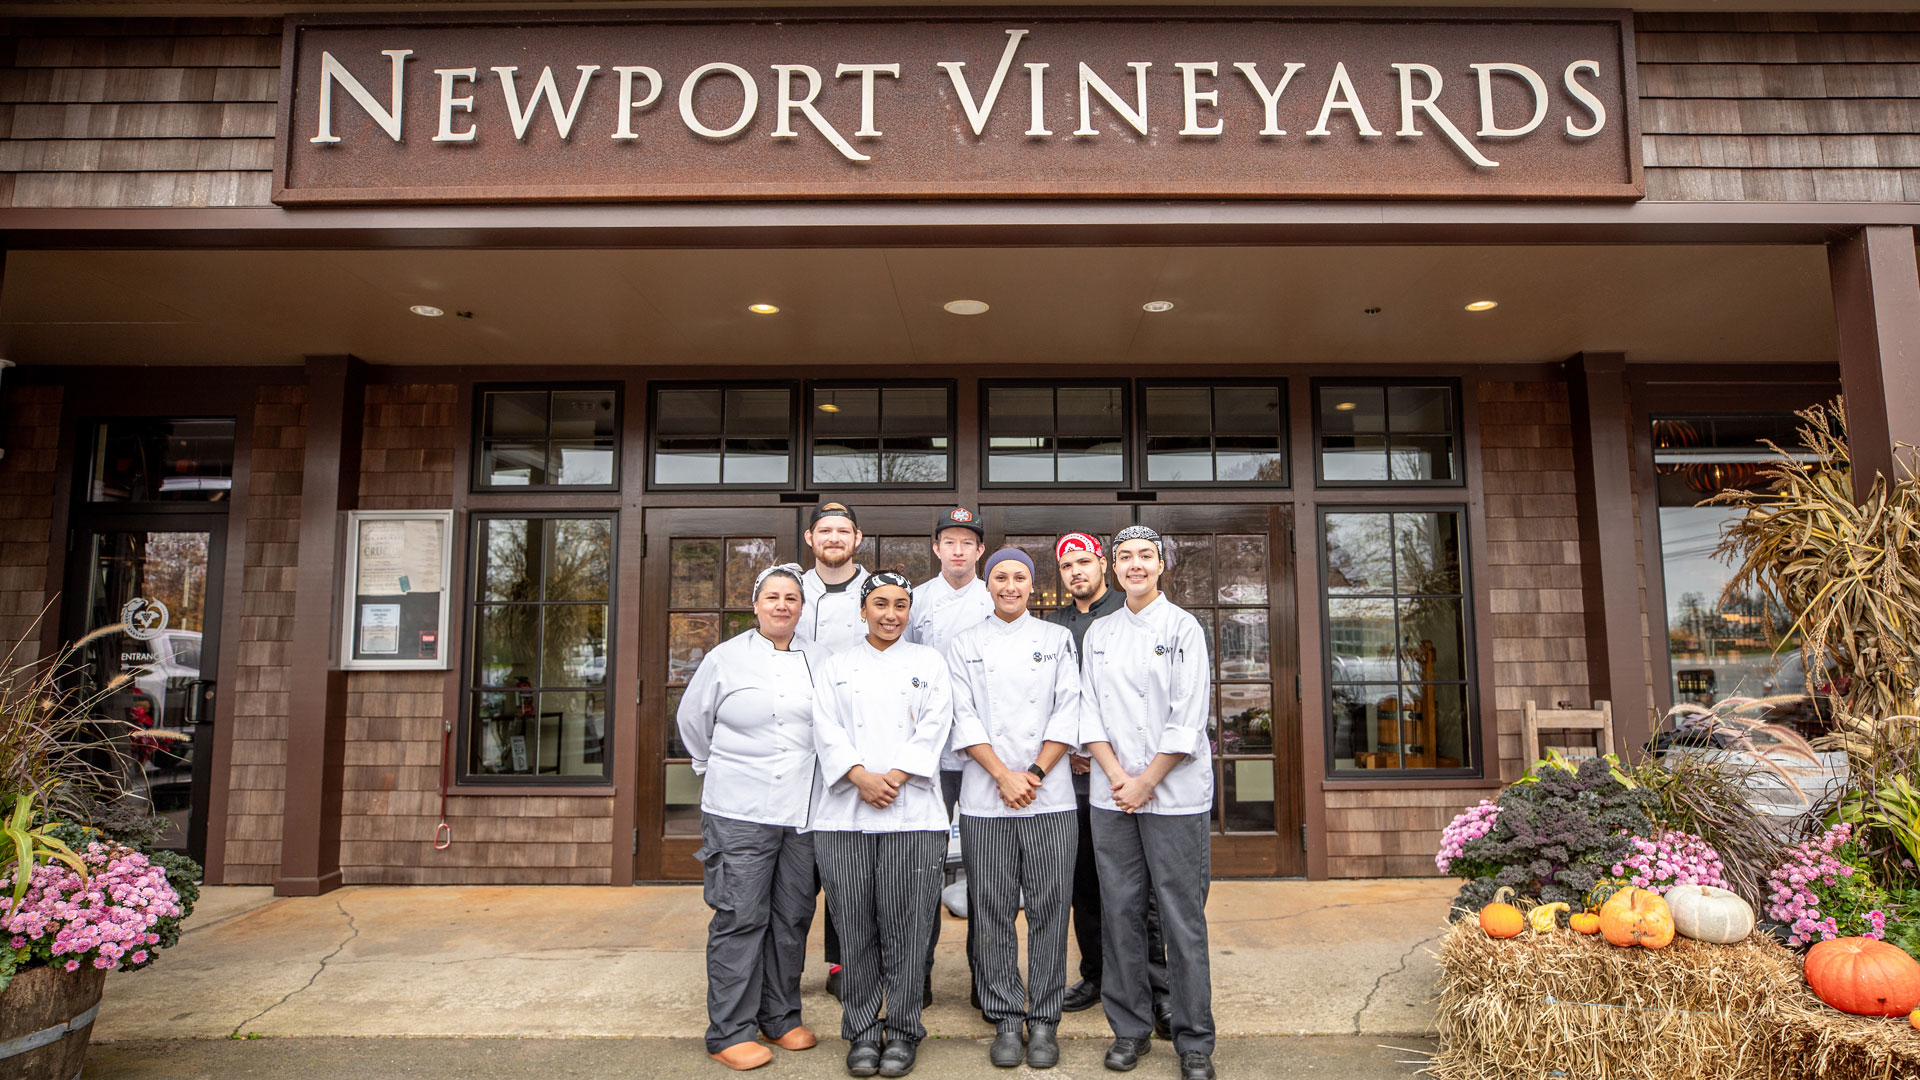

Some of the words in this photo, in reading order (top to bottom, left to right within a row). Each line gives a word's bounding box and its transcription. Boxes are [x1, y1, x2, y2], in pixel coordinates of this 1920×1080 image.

[310, 49, 900, 161] NEWPORT
[937, 29, 1607, 167] VINEYARDS
[121, 652, 165, 661] ENTRANC
